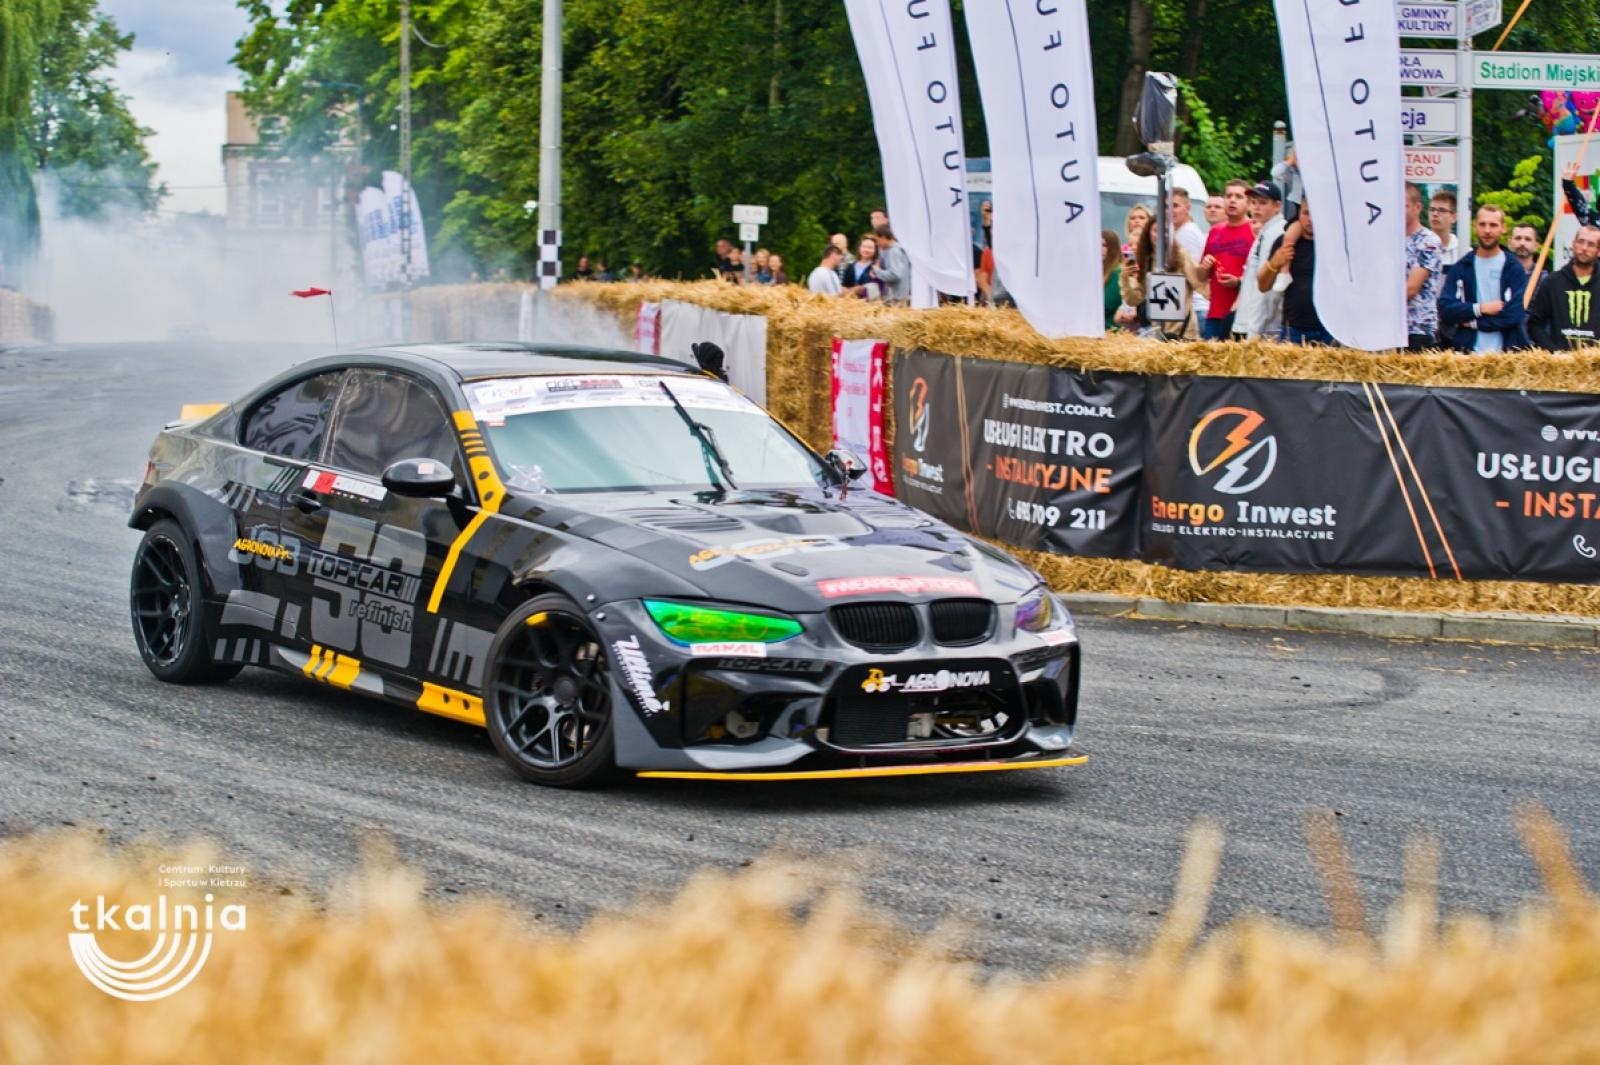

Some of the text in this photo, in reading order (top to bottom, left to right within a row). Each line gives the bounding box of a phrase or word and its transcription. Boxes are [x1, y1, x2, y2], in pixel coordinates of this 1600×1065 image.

[1402, 8, 1449, 19] GMINNY
[1398, 20, 1452, 32] KULTURY
[1400, 56, 1422, 67] ŁA
[1480, 61, 1600, 86] Stadion Miejski
[1401, 108, 1426, 129] cja
[1405, 166, 1435, 177] EGO
[1022, 424, 1115, 458] ELEKTRO
[1477, 452, 1600, 483] USŁUGI
[1070, 507, 1106, 530] 211
[1152, 496, 1337, 527] Energo Inwest
[1179, 526, 1335, 541] ELEKTRO-INSTALACYJNE
[348, 599, 412, 634] refinish
